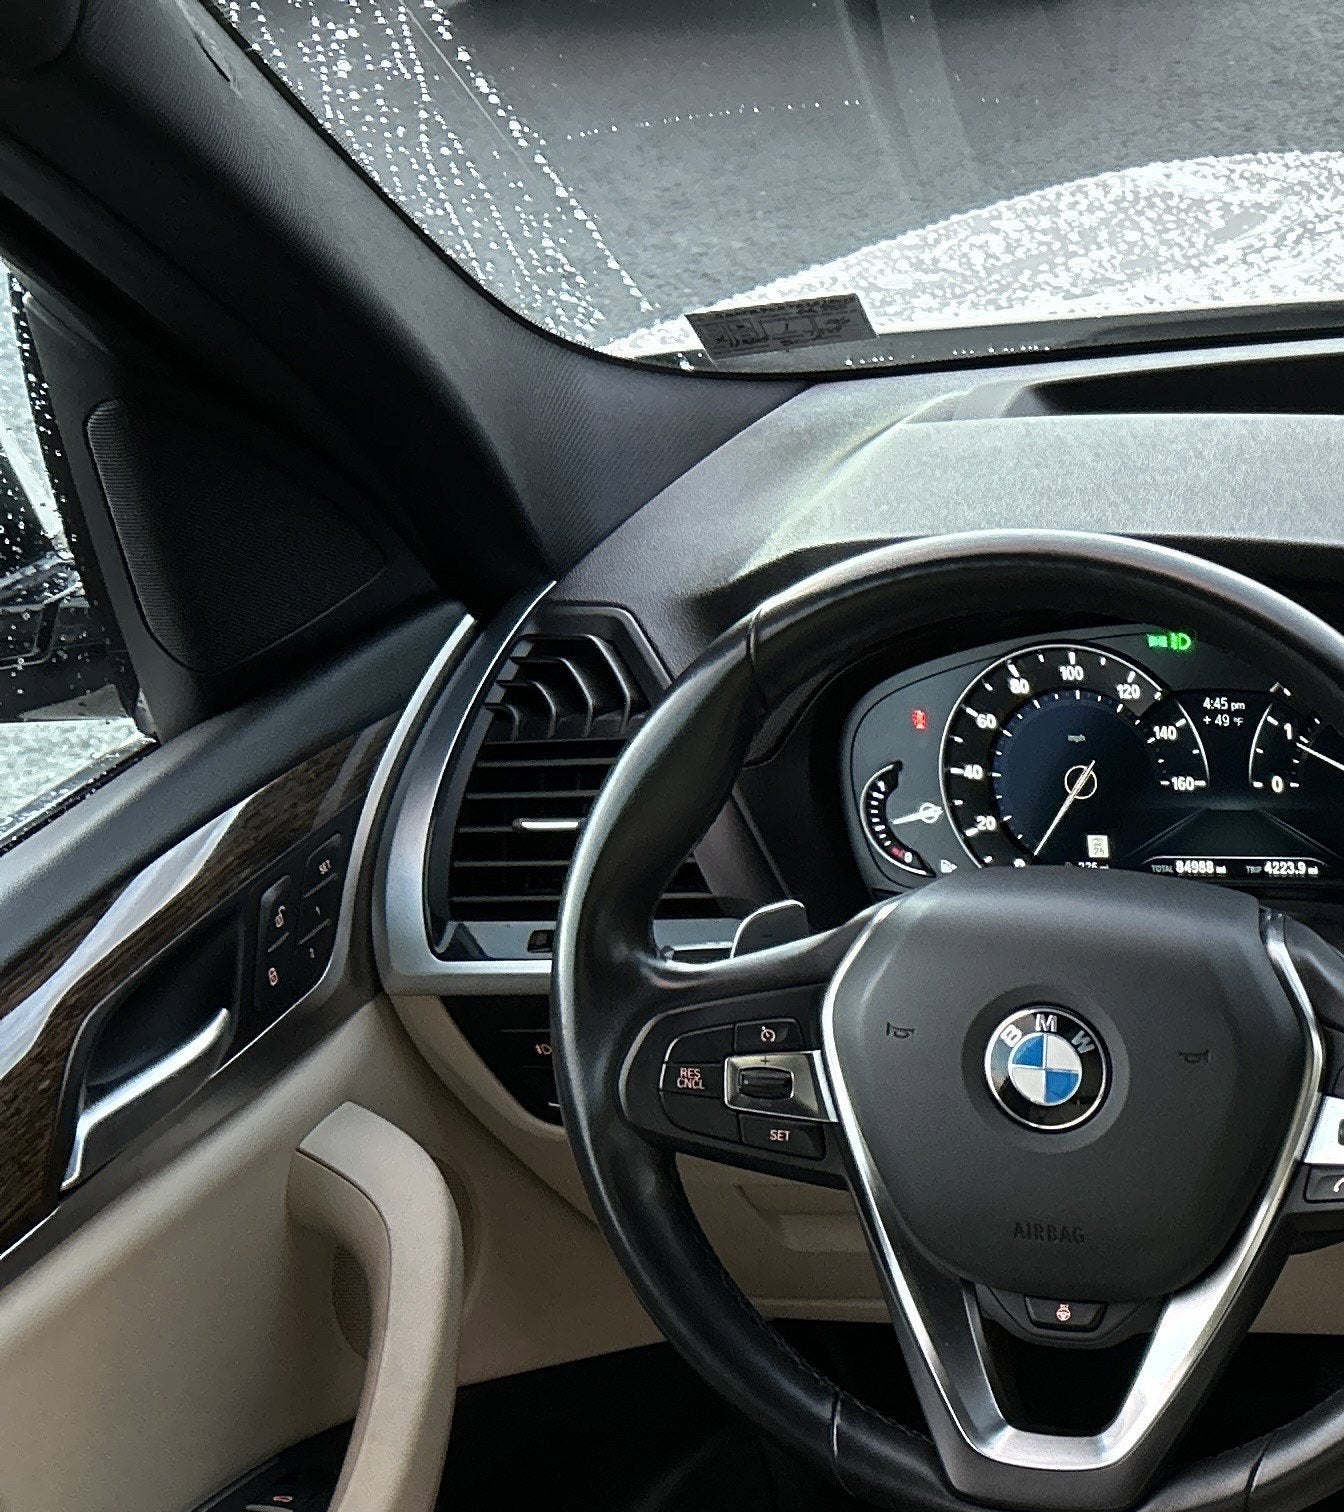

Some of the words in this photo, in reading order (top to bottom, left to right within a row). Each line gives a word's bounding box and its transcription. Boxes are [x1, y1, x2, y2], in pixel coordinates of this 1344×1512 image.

[1059, 665, 1084, 681] 100
[1009, 677, 1030, 694] 80
[1116, 683, 1141, 699] 120
[1202, 696, 1229, 710] 4:45
[1230, 701, 1246, 712] pm
[976, 712, 997, 729] 60
[1214, 714, 1230, 727] 49
[1153, 725, 1177, 740] 140
[1283, 722, 1293, 740] 1
[964, 764, 984, 780] 40
[1171, 776, 1195, 791] 160
[1271, 775, 1284, 793] 0
[976, 815, 997, 831] 20
[1151, 864, 1174, 874] TOTAL
[1263, 860, 1306, 875] 4223.9
[1000, 1013, 1096, 1055] BMW
[679, 1067, 702, 1079] RES
[676, 1077, 705, 1090] CNCL
[769, 1129, 791, 1142] SET
[1013, 1221, 1086, 1245] AIRBAG
